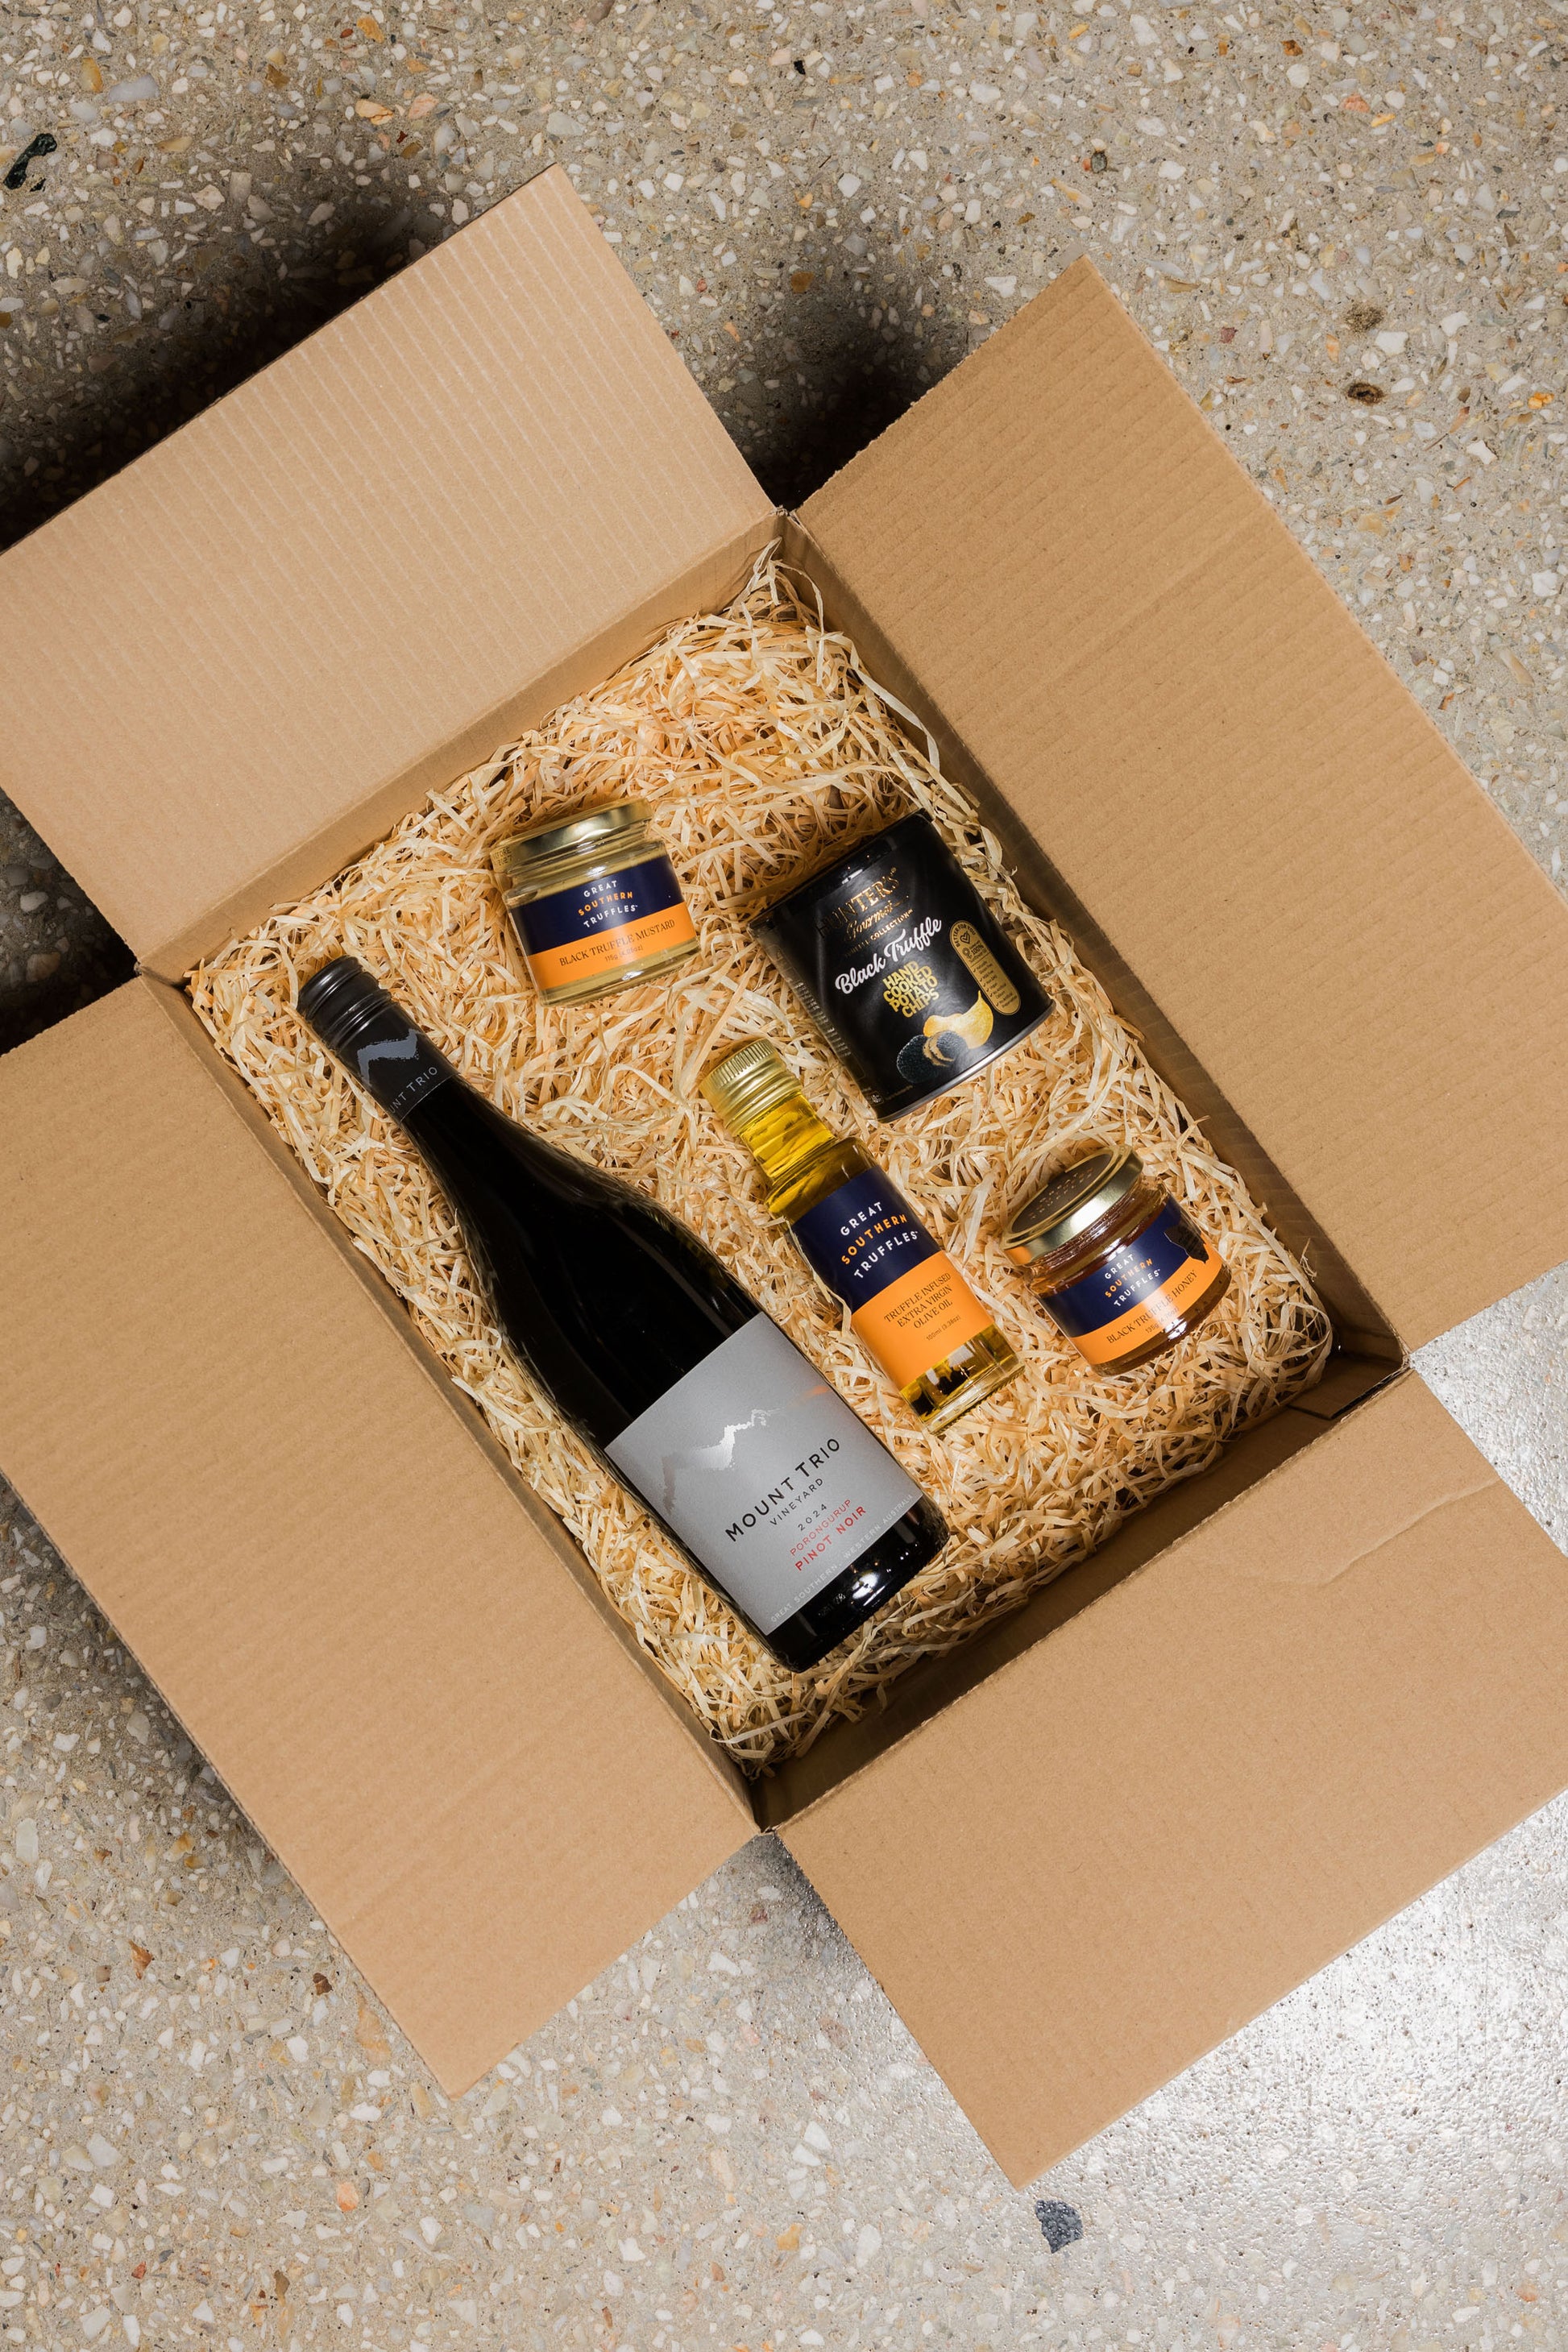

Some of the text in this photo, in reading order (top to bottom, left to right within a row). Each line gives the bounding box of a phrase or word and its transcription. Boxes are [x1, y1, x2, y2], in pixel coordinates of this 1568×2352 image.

[578, 891, 633, 916] SOUTHERN
[583, 881, 617, 898] GREAT
[844, 899, 894, 941] Gourmet
[967, 926, 976, 935] YOU
[559, 919, 675, 966] BLACK TRUFFLE MUSTARD
[604, 954, 618, 962] 115g
[835, 953, 886, 994] Black
[884, 916, 942, 962] Truffle
[971, 944, 985, 955] 100%
[882, 960, 919, 989] HAND
[883, 965, 932, 1002] COOKED
[889, 976, 938, 1012] POTATO
[902, 988, 940, 1018] CHIPS
[406, 1067, 438, 1092] TRIO
[840, 1201, 882, 1236] GREAT
[841, 1214, 907, 1264] SOUTHERN
[1105, 1254, 1134, 1279] GREAT
[1105, 1259, 1153, 1297] SOUTHERN
[884, 1272, 952, 1322] TRUFFLE INFUSED
[897, 1284, 952, 1328] EXTRA VIRGIN
[914, 1299, 953, 1329] OLIVE OIL
[1106, 1270, 1197, 1343] BLACK TRUFFLE HONEY
[725, 1438, 840, 1542] MOUNT TRIO
[769, 1478, 823, 1526] VINEYARD
[790, 1500, 852, 1557] PORONGURUP
[798, 1504, 828, 1532] 2024
[794, 1506, 867, 1571] PINOT NOIR
[770, 1602, 794, 1623] GREAT
[844, 1524, 881, 1560] WESTERN
[882, 1494, 914, 1524] AUSTRALIA
